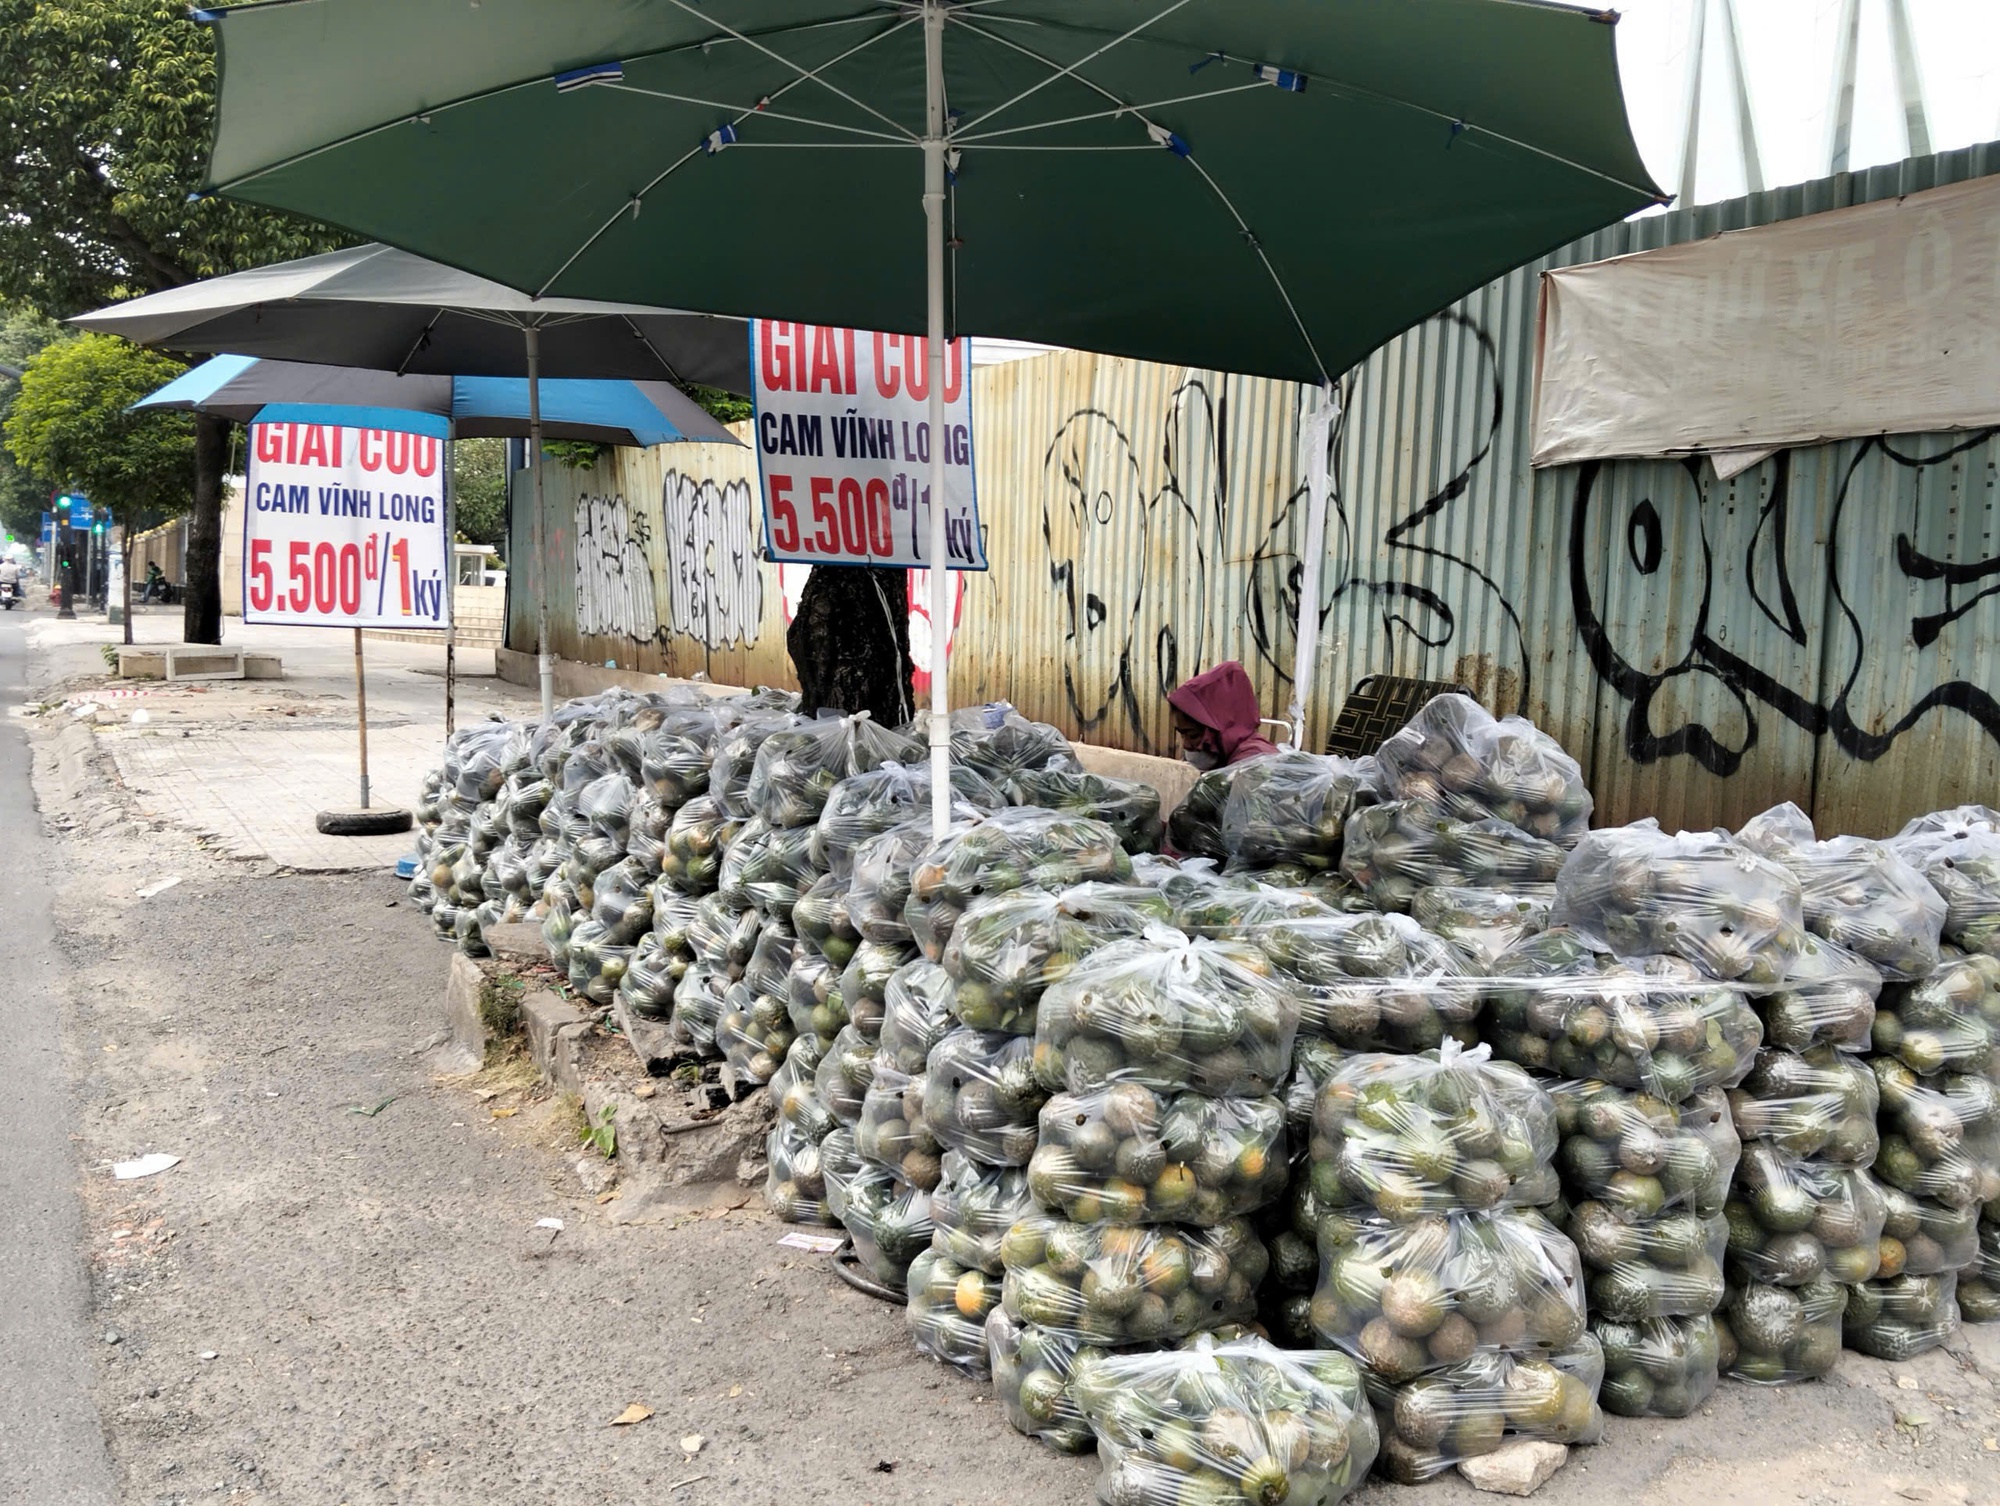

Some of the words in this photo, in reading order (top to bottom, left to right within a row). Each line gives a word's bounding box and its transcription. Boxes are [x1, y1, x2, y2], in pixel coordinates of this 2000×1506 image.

[760, 412, 824, 457] CAM
[830, 407, 896, 460] VĨNH
[256, 482, 309, 514] CAM
[318, 482, 371, 519] VĨNH
[379, 492, 435, 524] LONG
